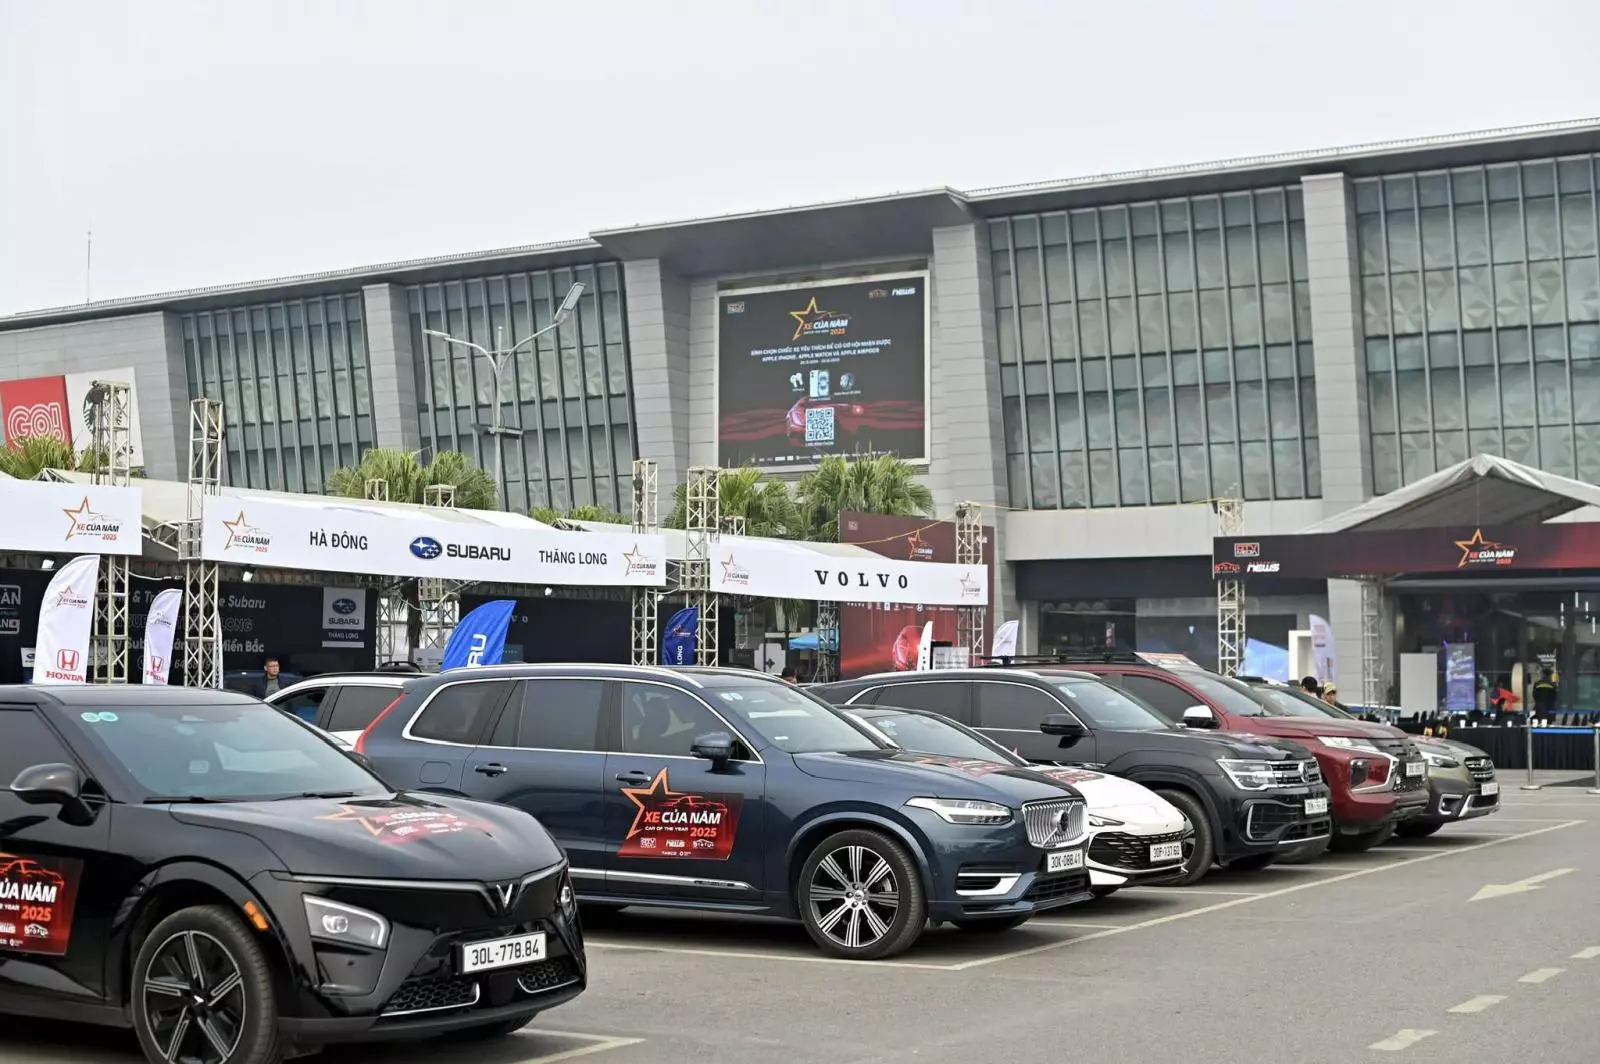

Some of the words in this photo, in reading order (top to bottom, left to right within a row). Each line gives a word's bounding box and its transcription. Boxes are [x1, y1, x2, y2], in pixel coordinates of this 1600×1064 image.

[76, 523, 85, 531] XE
[86, 521, 101, 531] CỦA
[102, 523, 119, 532] NĂM
[310, 528, 327, 547] HÀ
[331, 531, 368, 550] ĐÔNG
[447, 544, 511, 561] SUBARU
[539, 548, 575, 564] THĂNG
[579, 552, 607, 565] LONG
[814, 570, 907, 589] VOLVO
[228, 594, 265, 608] Subaru
[245, 639, 265, 652] Bắc
[45, 671, 84, 682] HONDA
[644, 811, 660, 823] XE
[662, 809, 688, 824] CỦA
[690, 810, 721, 825] NĂM
[690, 827, 717, 837] 2025
[0, 877, 19, 899] ỦA
[21, 881, 57, 903] NĂM
[21, 905, 52, 922] 2025
[472, 939, 539, 966] 30L-778.84
